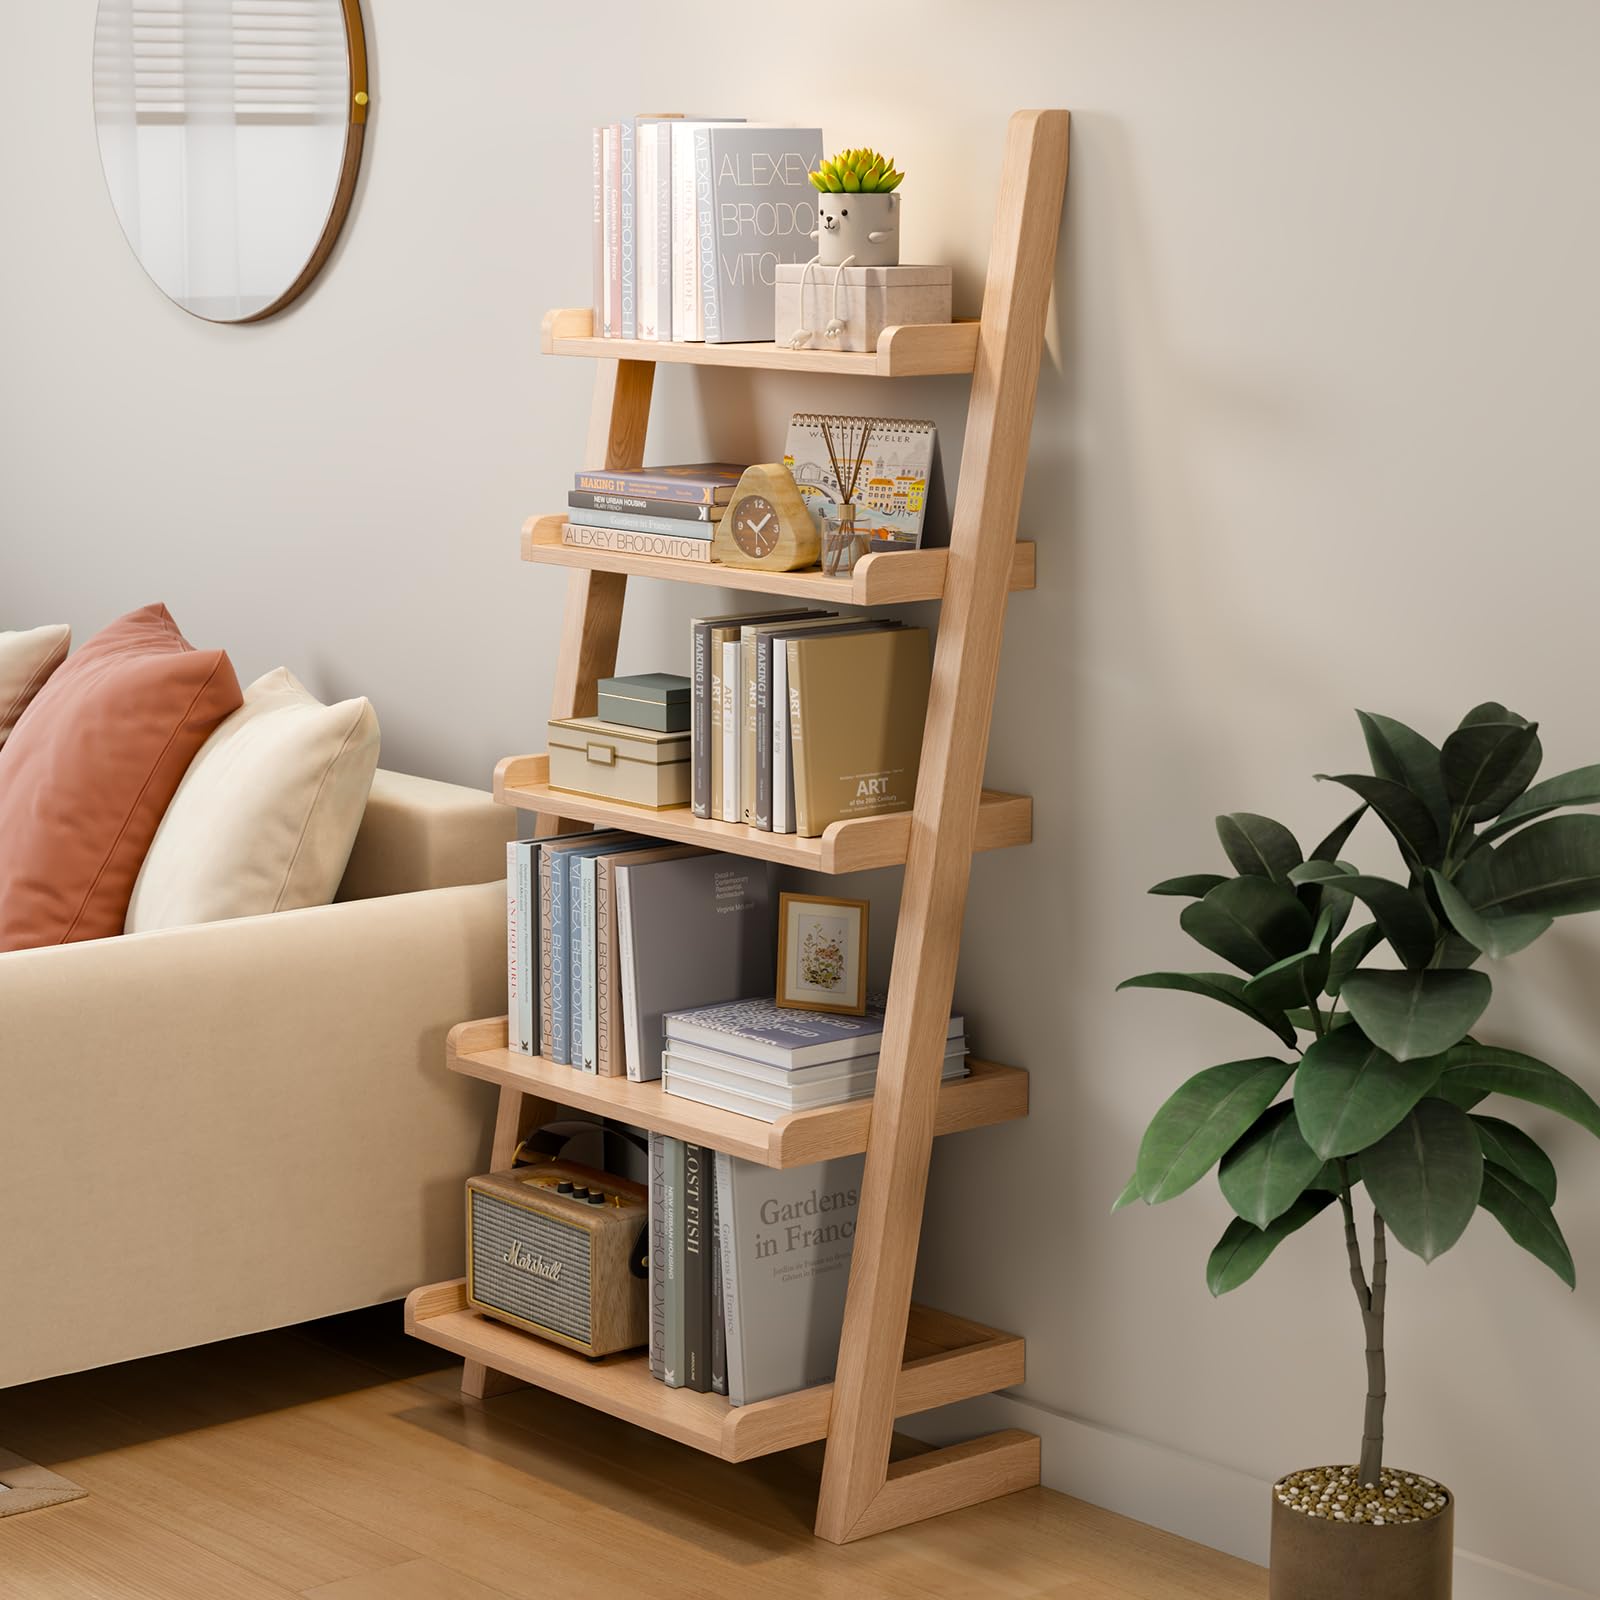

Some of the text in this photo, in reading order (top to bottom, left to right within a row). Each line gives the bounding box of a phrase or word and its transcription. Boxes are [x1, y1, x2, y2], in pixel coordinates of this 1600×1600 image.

[718, 152, 817, 187] ALEXEY
[622, 123, 633, 326] ALEXEY BRODOVITCH
[695, 134, 717, 330] ALEXEY BRODOVITCH
[720, 201, 819, 237] BRODO-
[855, 433, 911, 444] TAVELER
[580, 477, 615, 491] MAKING
[616, 480, 625, 492] IT
[593, 495, 647, 508] NEW URBAN HOUSING
[754, 500, 764, 509] 12
[737, 521, 744, 531] 9
[773, 524, 779, 534] 3
[565, 527, 700, 560] ALEXEY BRODOVITCH
[755, 546, 761, 556] 6
[695, 633, 704, 682] MAKING
[758, 642, 766, 693] MAKING
[695, 683, 704, 698] IT
[711, 674, 721, 705] ART
[724, 685, 732, 714] ART
[749, 680, 757, 709] ART
[758, 693, 766, 708] IT
[789, 687, 801, 719] ART
[856, 777, 888, 797] ART
[542, 850, 552, 1047] ALEXEY BRODOVITCH
[598, 862, 608, 1063] ALEXEY BRODOVITCH
[687, 1144, 699, 1255] LOST FISH
[760, 1189, 858, 1225] Gardens
[755, 1221, 857, 1259] in Franc
[503, 1239, 562, 1280] Marshall
[721, 1223, 736, 1335] Gardens in France
